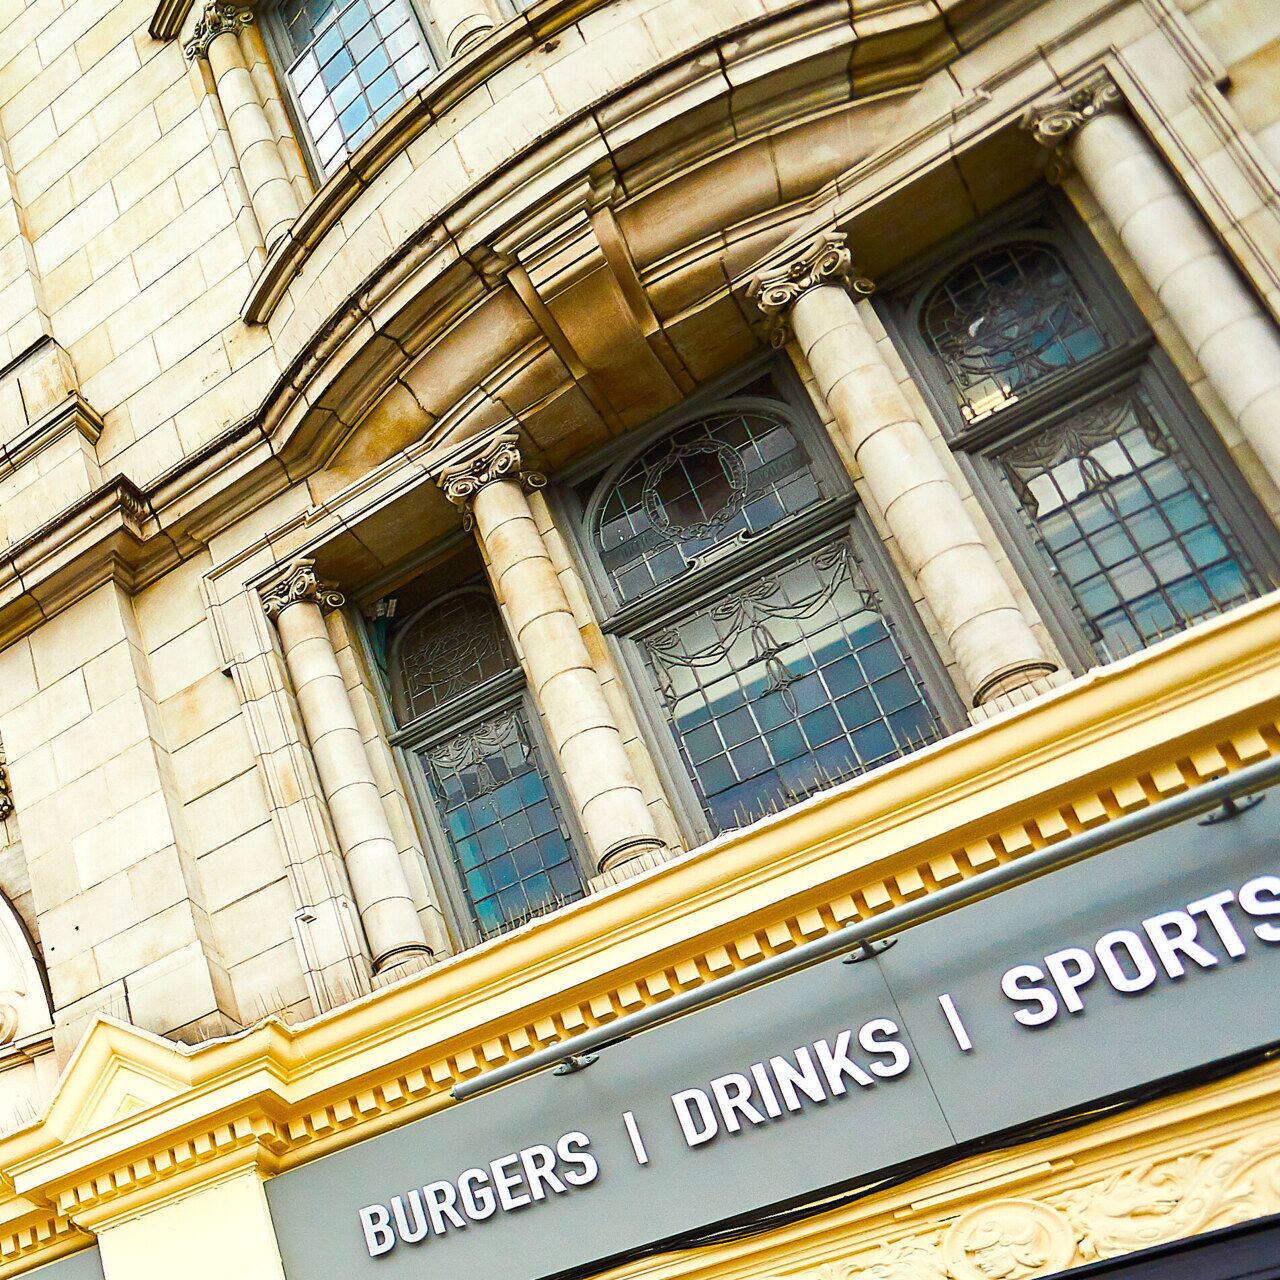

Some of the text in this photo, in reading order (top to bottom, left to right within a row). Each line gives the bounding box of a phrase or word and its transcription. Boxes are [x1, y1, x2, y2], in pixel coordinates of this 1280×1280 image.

[358, 875, 1280, 1258] BURGERS DRINKS SPORTS
